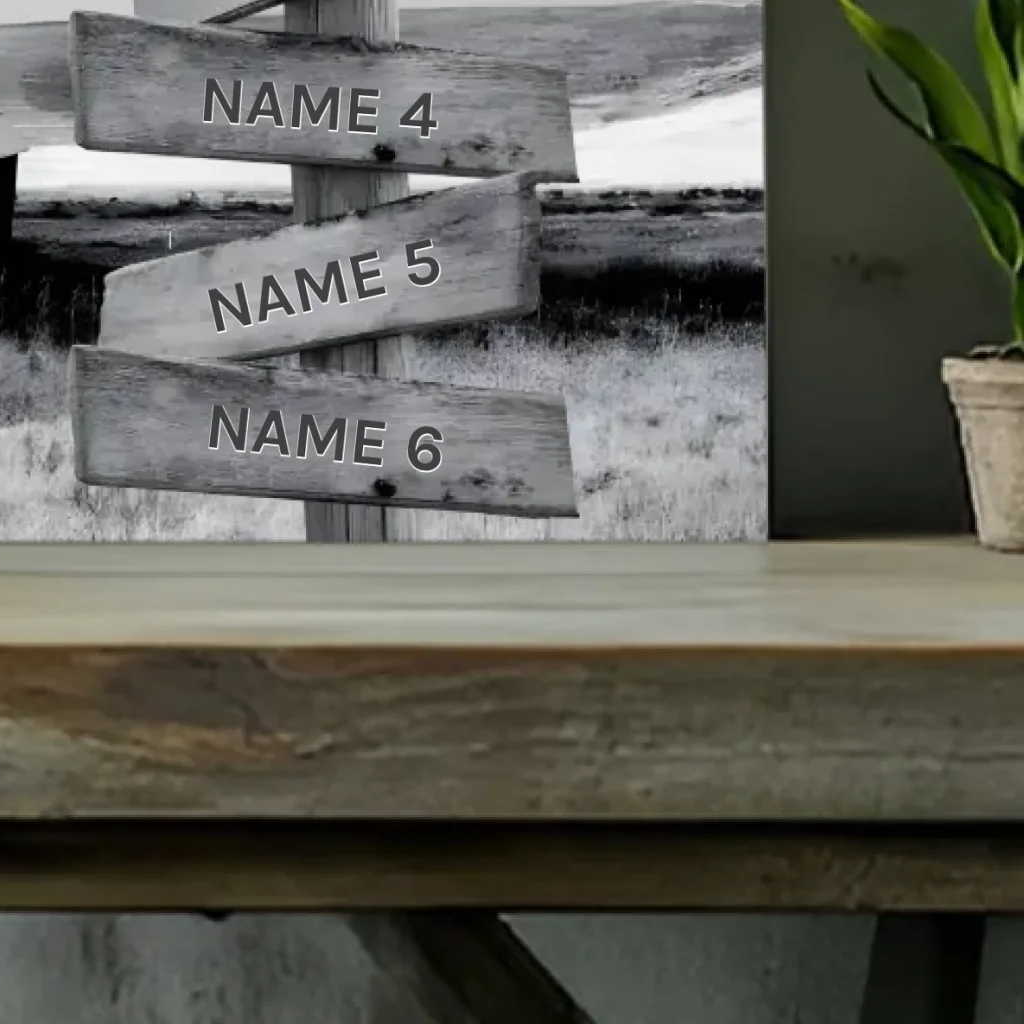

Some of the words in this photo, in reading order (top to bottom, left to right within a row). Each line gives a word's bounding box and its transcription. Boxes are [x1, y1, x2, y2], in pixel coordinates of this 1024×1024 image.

[203, 78, 380, 135] NAME
[399, 92, 439, 139] 4
[208, 250, 387, 334] NAME
[405, 238, 441, 288] 5
[208, 404, 387, 467] NAME
[407, 426, 444, 473] 6
